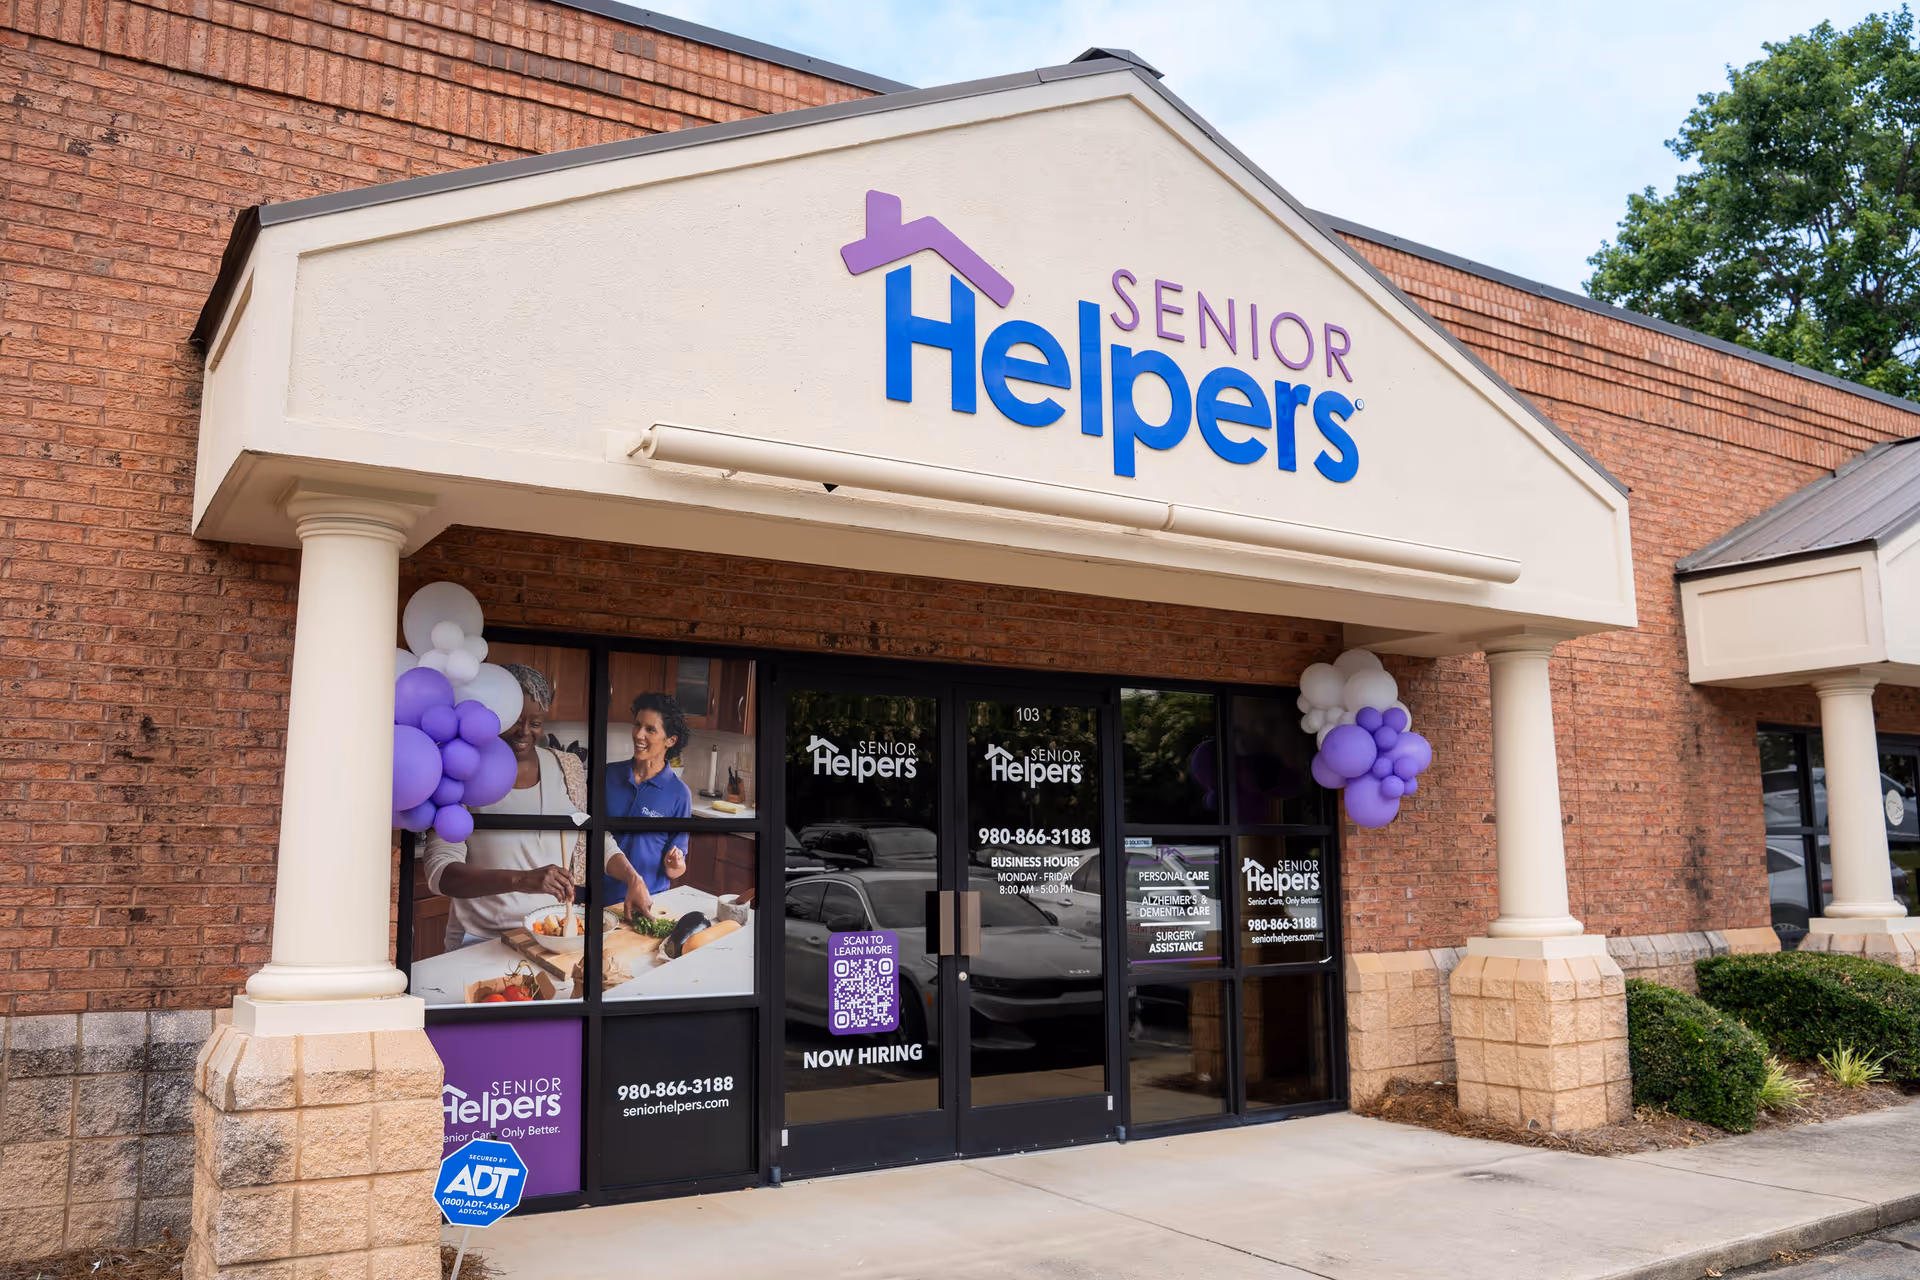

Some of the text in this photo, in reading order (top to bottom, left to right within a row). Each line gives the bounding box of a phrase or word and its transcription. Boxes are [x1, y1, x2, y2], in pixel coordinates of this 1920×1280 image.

[1110, 268, 1353, 382] SENIOR
[1016, 707, 1040, 722] 103
[859, 740, 917, 756] SENIOR
[1030, 748, 1081, 762] SENIOR
[978, 827, 1091, 845] 980-866-3188
[991, 856, 1080, 868] BUSINESS HOURS
[1277, 859, 1319, 872] SENIOR
[997, 872, 1038, 882] MONDAY
[1043, 872, 1074, 881] FRIDAY
[1139, 871, 1210, 882] PERSONAL CARE
[999, 885, 1018, 895] 8:00
[1019, 885, 1034, 894] AM
[1040, 884, 1059, 894] 5:00
[1060, 884, 1073, 894] PM
[1141, 894, 1208, 906] ALZHEIMER'S &
[1247, 897, 1267, 906] Senior
[1268, 896, 1284, 906] Care,
[1285, 896, 1300, 907] Only
[1140, 906, 1211, 917] DEMENTIA CARE
[1247, 916, 1317, 931] 980-866-3188
[843, 935, 884, 946] SCAN TO
[1156, 930, 1196, 942] SURGERY
[1251, 932, 1315, 944] seniorhelpers.com
[834, 945, 893, 956] LEARN MORE
[1149, 941, 1204, 953] ASSISTANCE
[803, 1043, 923, 1069] NOW HIRING
[491, 1077, 561, 1097] SENIOR
[617, 1075, 734, 1101] 980-866-3188
[623, 1098, 729, 1117] seniorhelpers.com
[443, 1132, 469, 1144] enior
[501, 1126, 526, 1140] Only
[528, 1125, 561, 1136] Better.
[468, 1154, 498, 1163] SECURED
[443, 1163, 520, 1199] ADT
[458, 1208, 489, 1216] ADT.COM
